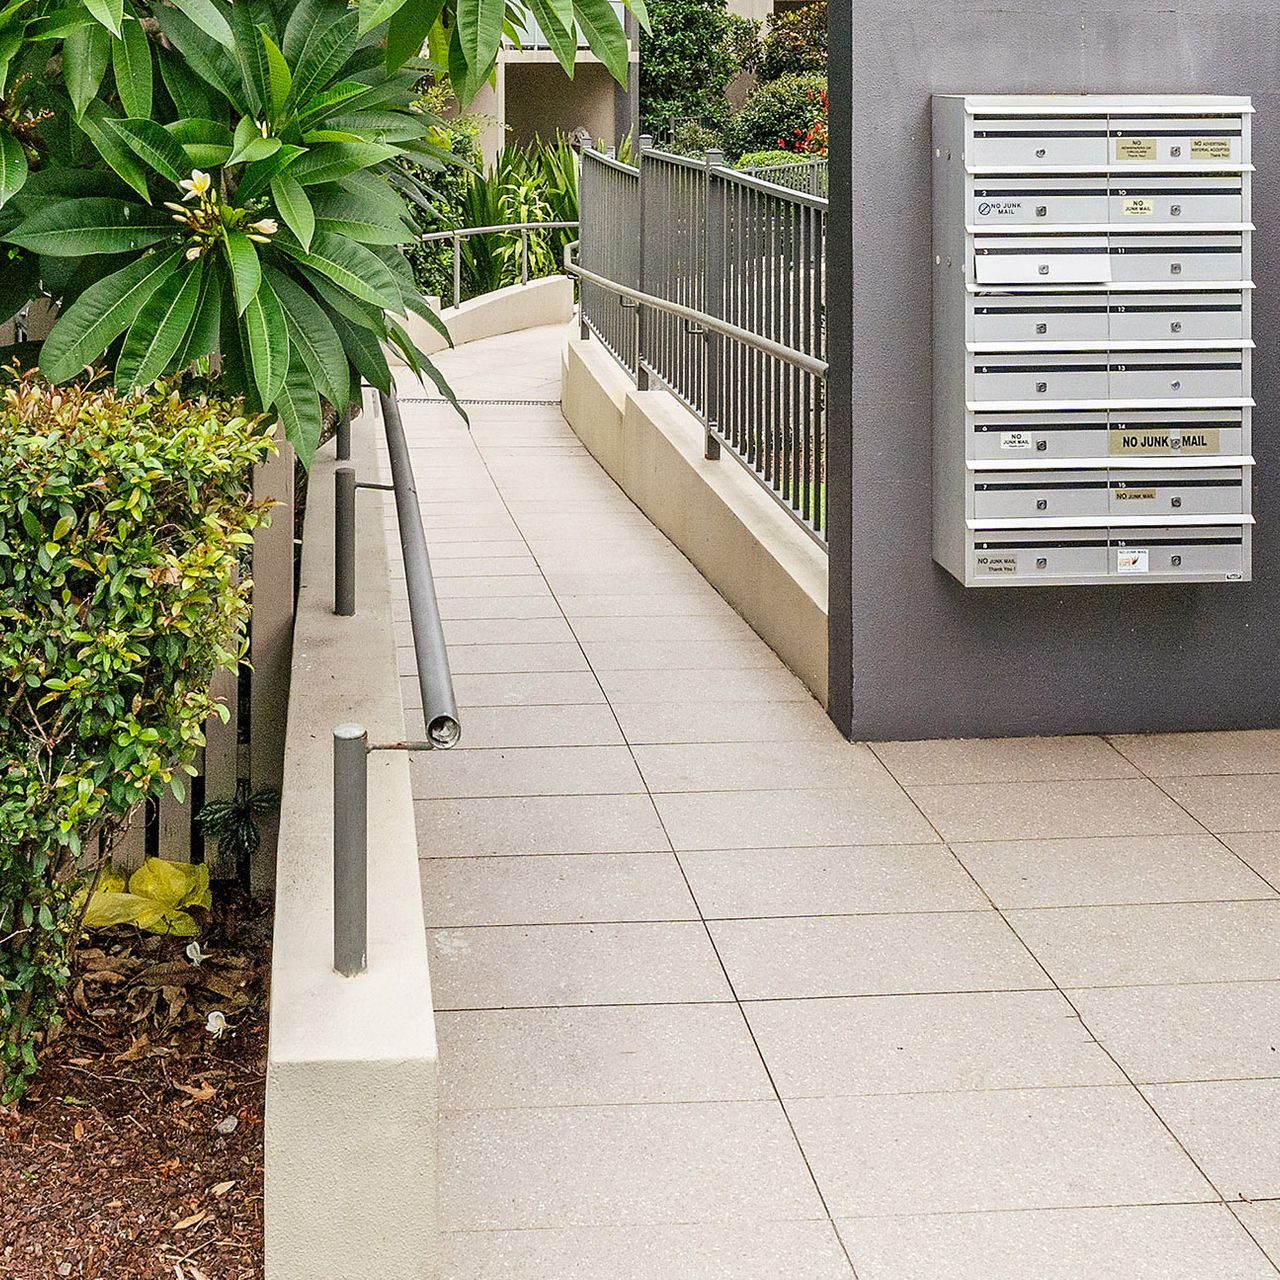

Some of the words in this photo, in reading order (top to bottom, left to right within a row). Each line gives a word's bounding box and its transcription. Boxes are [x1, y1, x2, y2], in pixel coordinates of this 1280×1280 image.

[1123, 436, 1138, 447] NO
[1140, 435, 1169, 447] JUNK
[1182, 435, 1207, 447] MAIL
